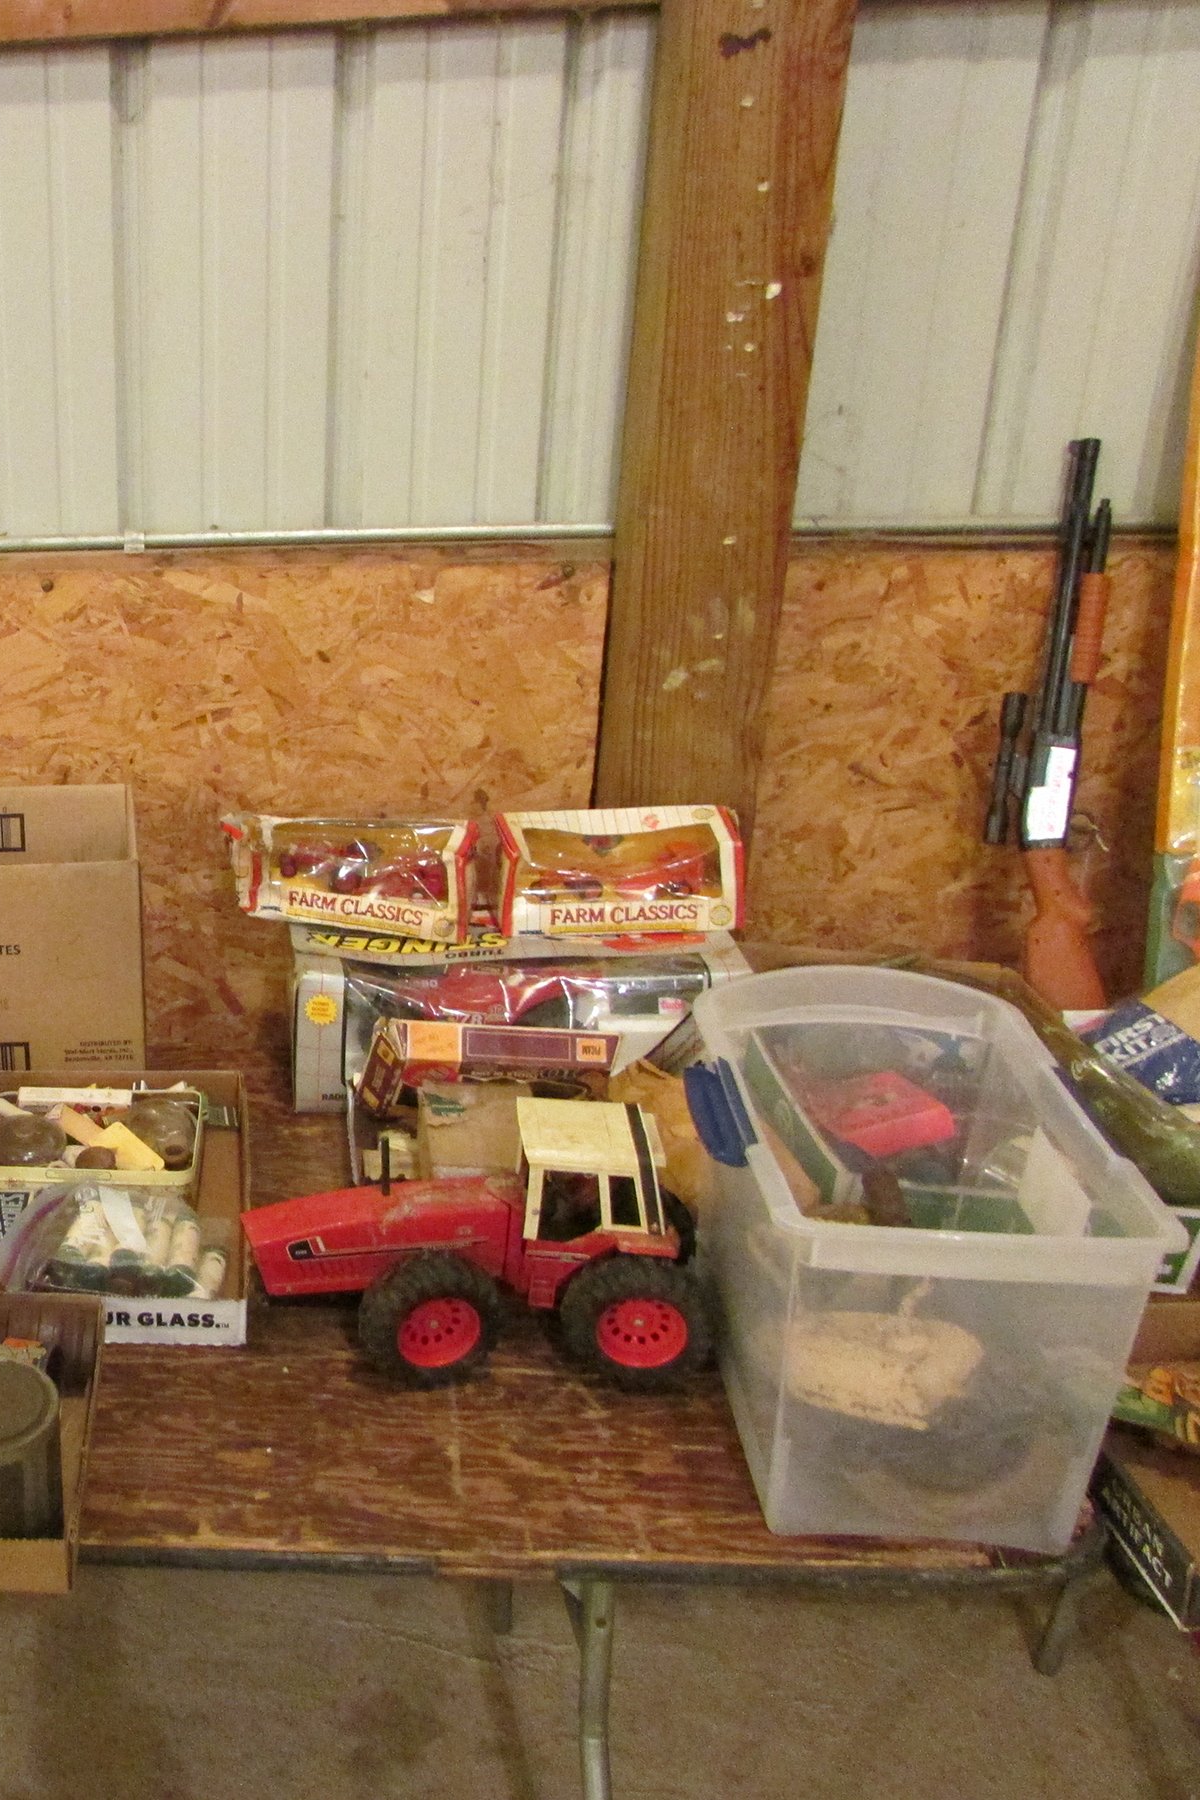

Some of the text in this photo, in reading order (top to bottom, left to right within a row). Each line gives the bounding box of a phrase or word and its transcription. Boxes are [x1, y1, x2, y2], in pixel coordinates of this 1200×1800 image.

[288, 891, 423, 926] FARM CLASSICS
[550, 904, 698, 925] FARM CLASSICS
[306, 931, 509, 954] STINGER
[445, 949, 504, 959] TURBO
[137, 1312, 220, 1328] GLASS.
